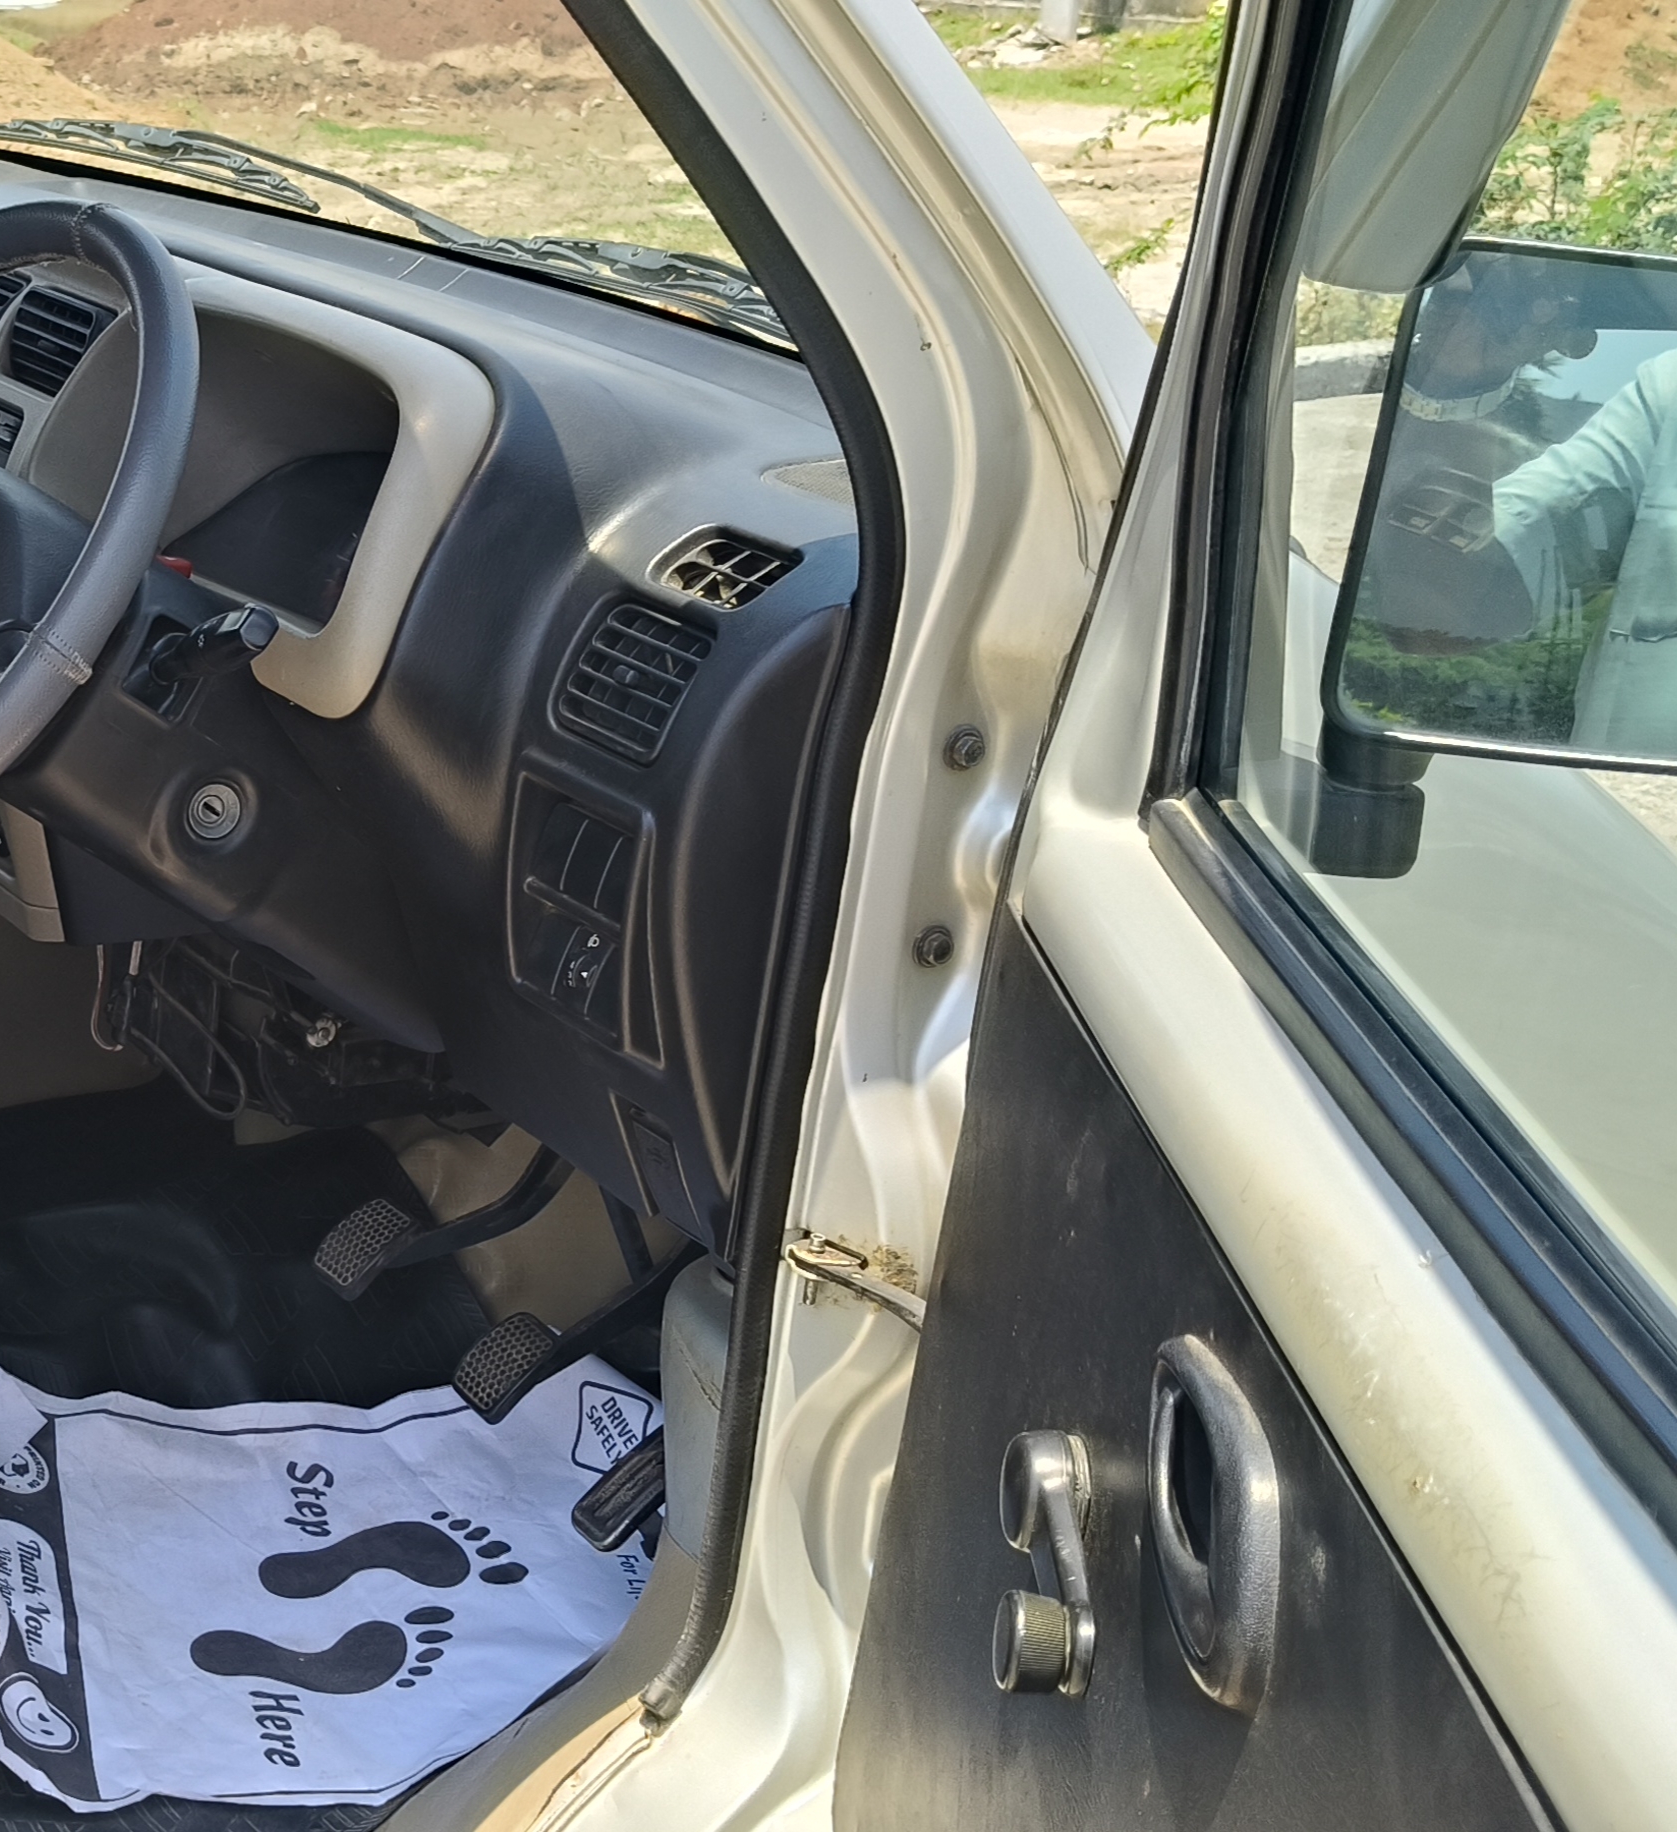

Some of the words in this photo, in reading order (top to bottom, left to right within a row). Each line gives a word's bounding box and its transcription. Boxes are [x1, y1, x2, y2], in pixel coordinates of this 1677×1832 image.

[585, 1404, 623, 1465] SAFELY
[600, 1395, 640, 1450] DRIVE
[284, 1460, 335, 1538] Step
[16, 1539, 46, 1596] Thank
[616, 1554, 640, 1575] For
[248, 1690, 305, 1768] Here
